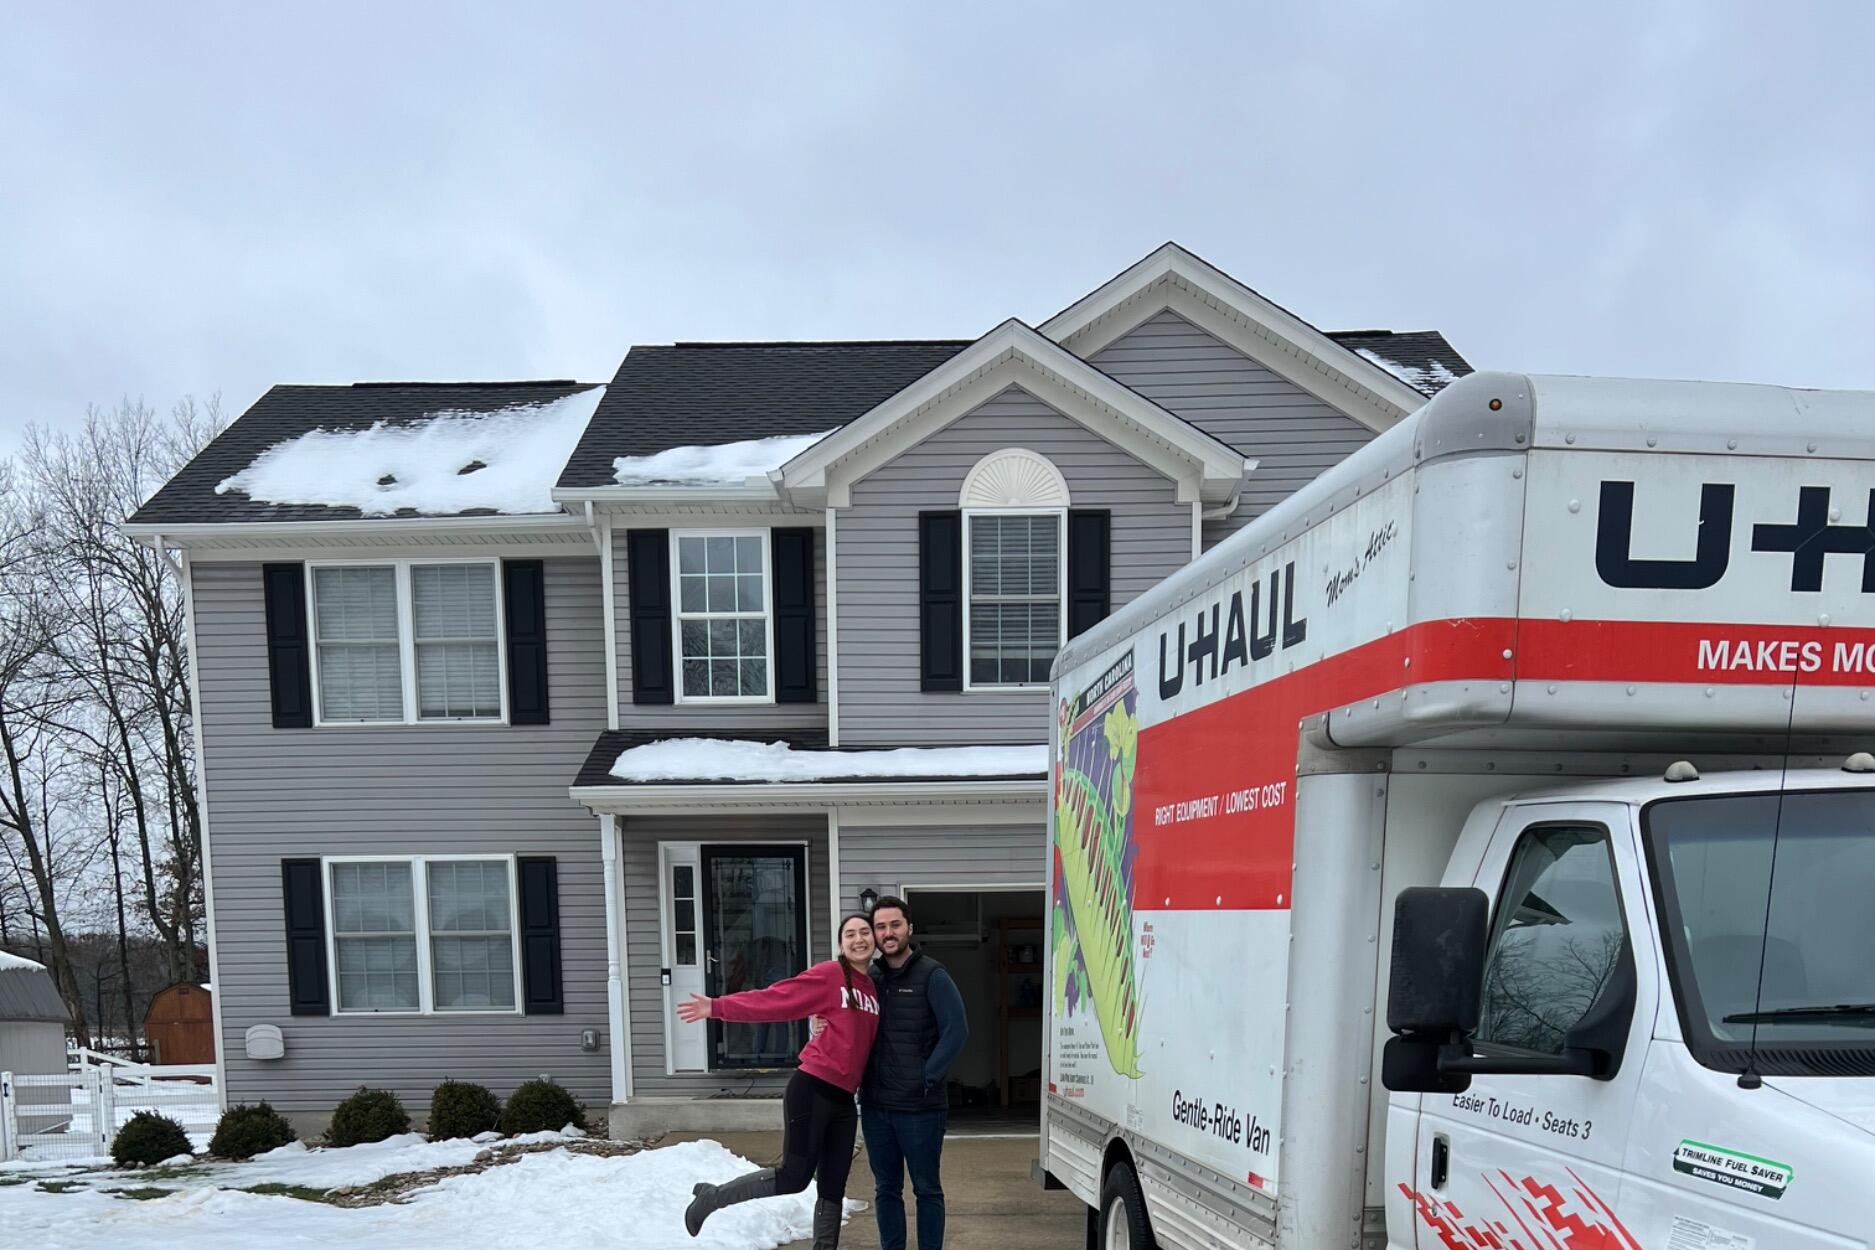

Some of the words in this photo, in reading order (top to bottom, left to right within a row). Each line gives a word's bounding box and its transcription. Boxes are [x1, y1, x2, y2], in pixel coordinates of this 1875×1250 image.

[1326, 556, 1360, 608] Mom's
[1362, 520, 1395, 572] Attic
[1697, 640, 1822, 672] MAKES
[1086, 680, 1104, 707] NORTH
[1104, 652, 1133, 692] CAROLINA
[1154, 804, 1175, 826] RIGHT
[1176, 796, 1219, 822] EQUIPMENT
[1225, 787, 1260, 814] LOWEST
[1261, 781, 1287, 808] COST
[1172, 1089, 1241, 1144] Gentle-Ride
[1246, 1113, 1271, 1156] Van
[1453, 1094, 1485, 1113] Easier
[1488, 1098, 1500, 1118] To
[1502, 1101, 1534, 1126] Load
[1542, 1111, 1580, 1138] Seats
[1581, 1120, 1593, 1140] 3
[1682, 1148, 1724, 1167] TRIMLINE
[1725, 1159, 1748, 1174] FUEL
[1692, 1167, 1716, 1179] SAVES
[1717, 1173, 1734, 1184] YOU
[1735, 1179, 1764, 1193] MONEY
